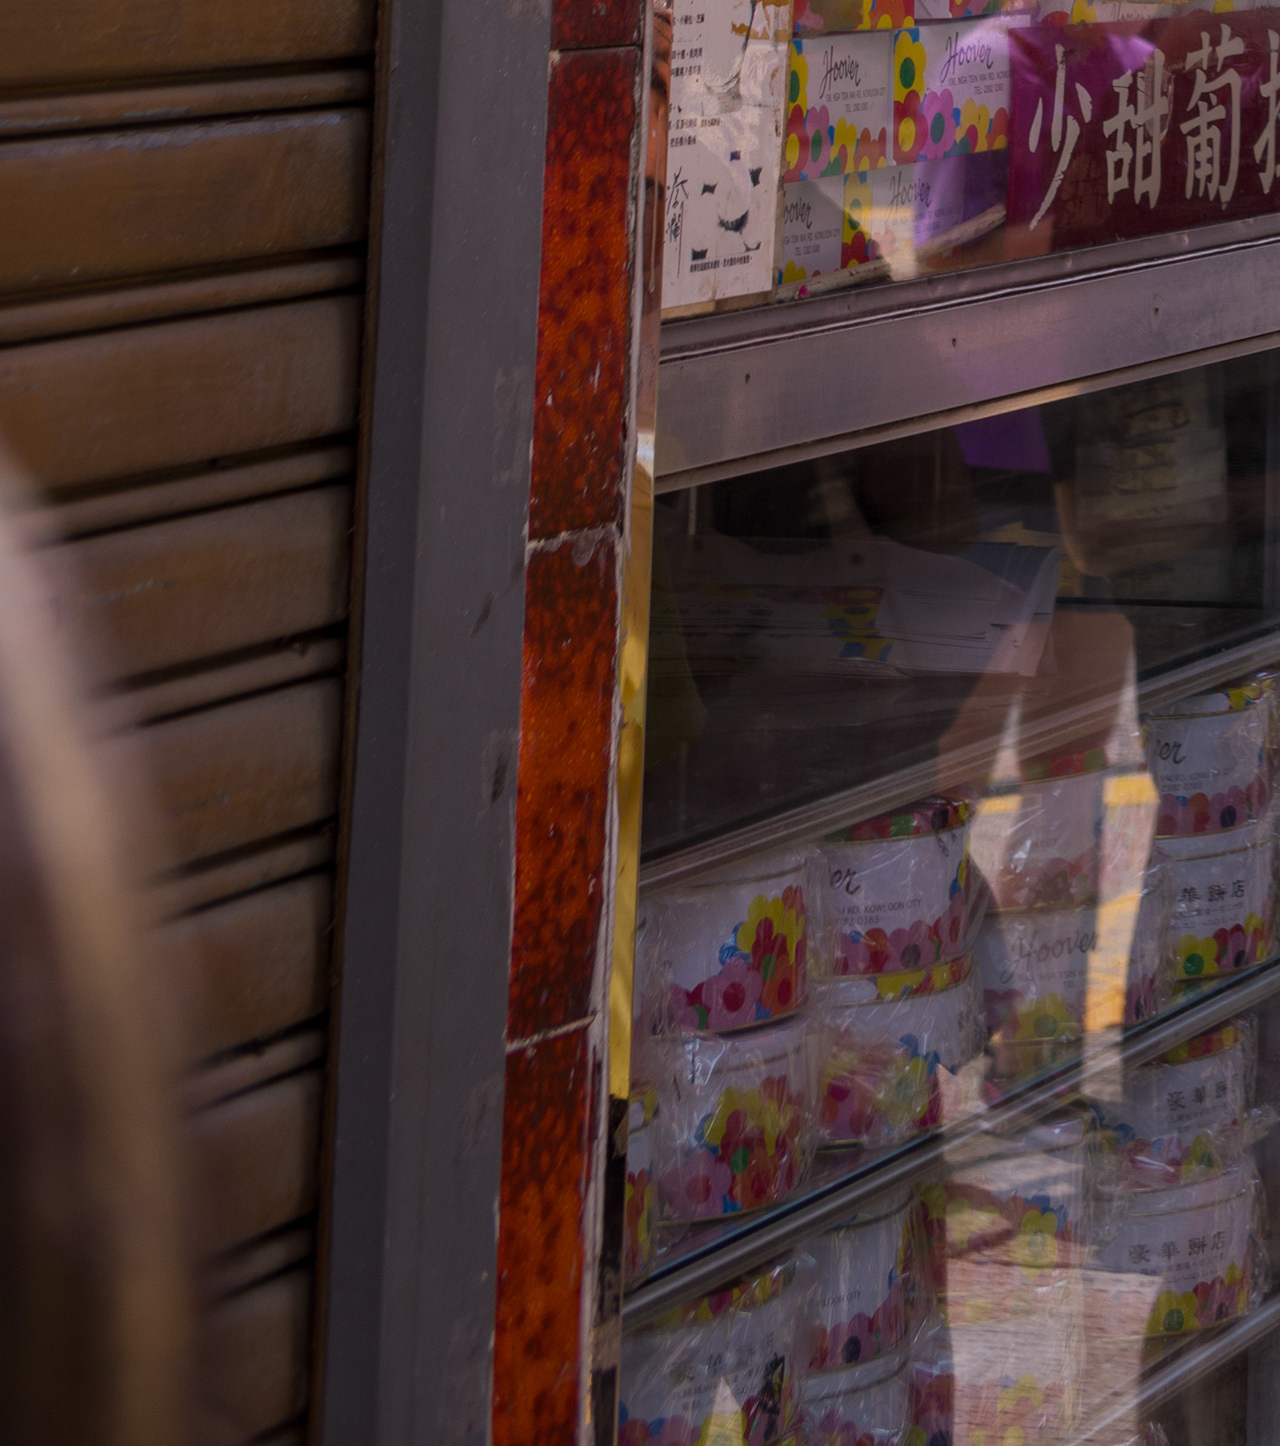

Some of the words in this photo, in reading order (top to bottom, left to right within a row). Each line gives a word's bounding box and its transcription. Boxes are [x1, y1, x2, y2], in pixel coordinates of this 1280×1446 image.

[819, 44, 861, 100] Hoover
[940, 31, 994, 86] Hoover
[888, 170, 933, 217] Hoover
[863, 900, 905, 913] KOWLOON
[906, 898, 922, 908] CITY
[1178, 879, 1246, 904] 華餅店
